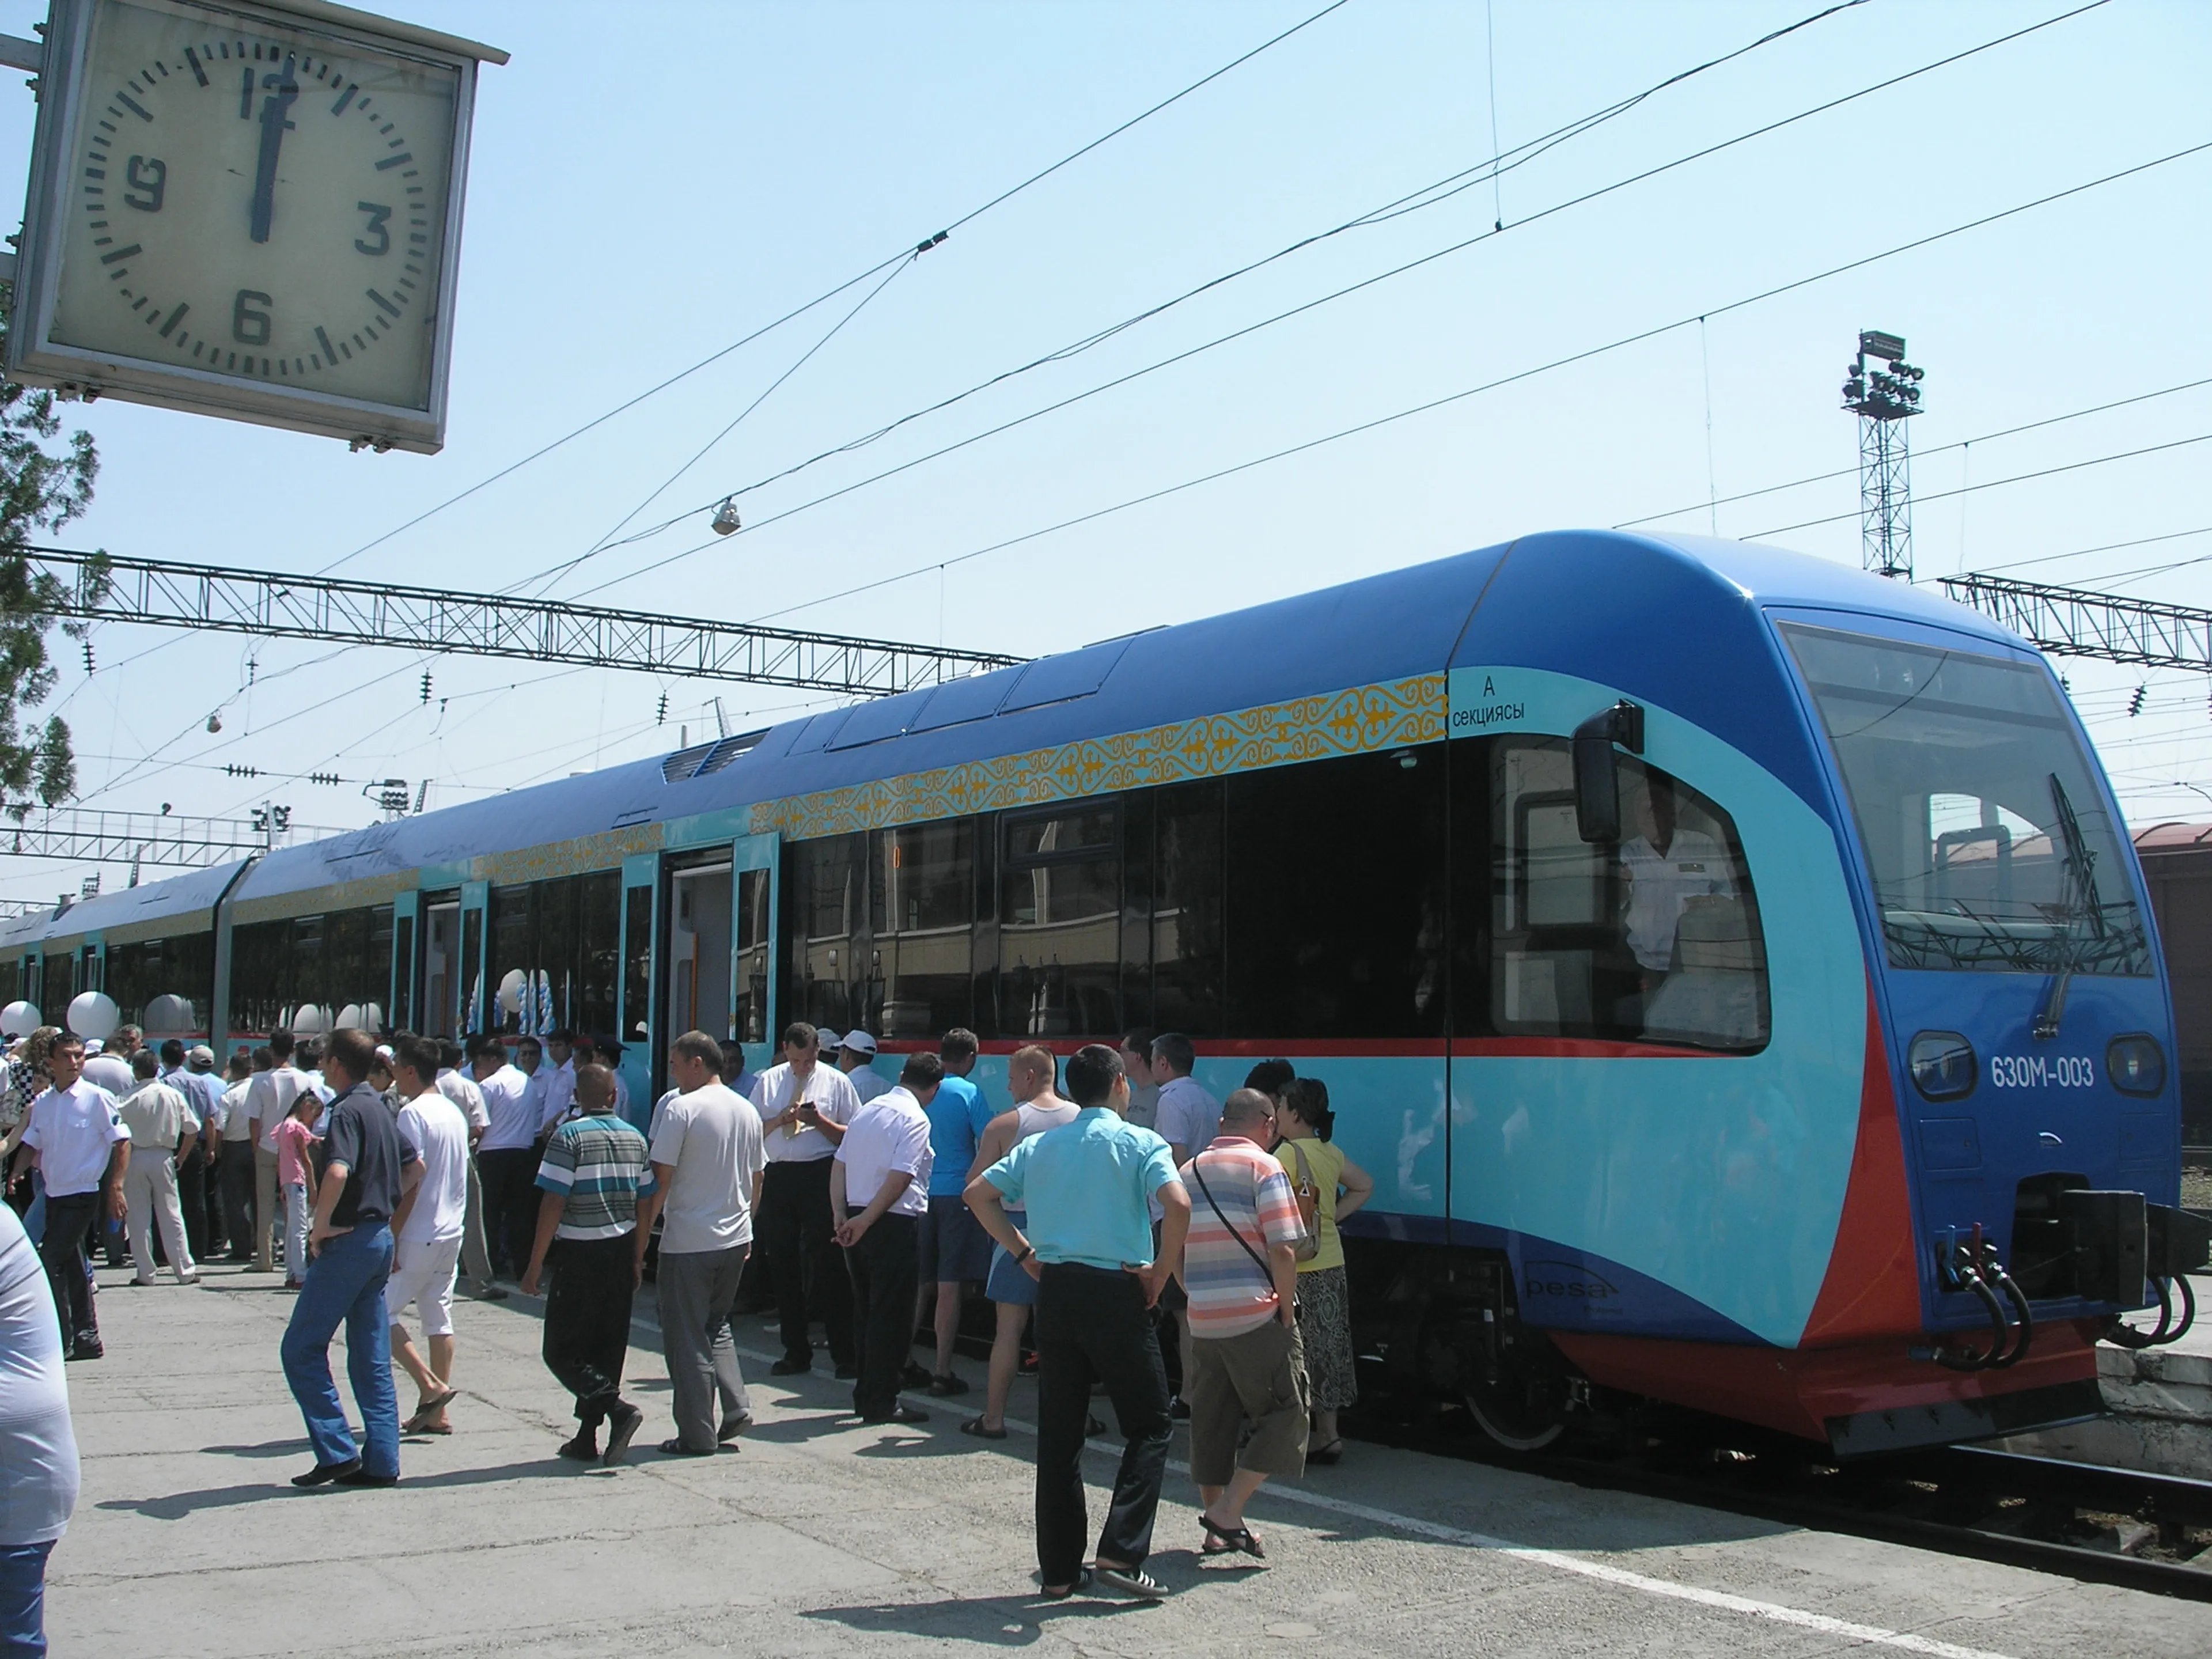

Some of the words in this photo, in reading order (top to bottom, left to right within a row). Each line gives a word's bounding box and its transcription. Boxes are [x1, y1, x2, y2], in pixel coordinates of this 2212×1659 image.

[124, 154, 167, 213] 9
[354, 201, 392, 257] 3
[233, 289, 272, 346] 6
[1453, 703, 1525, 727] секциясы
[1991, 1056, 2094, 1088] 630M-003
[1527, 1279, 1608, 1298] pesa
